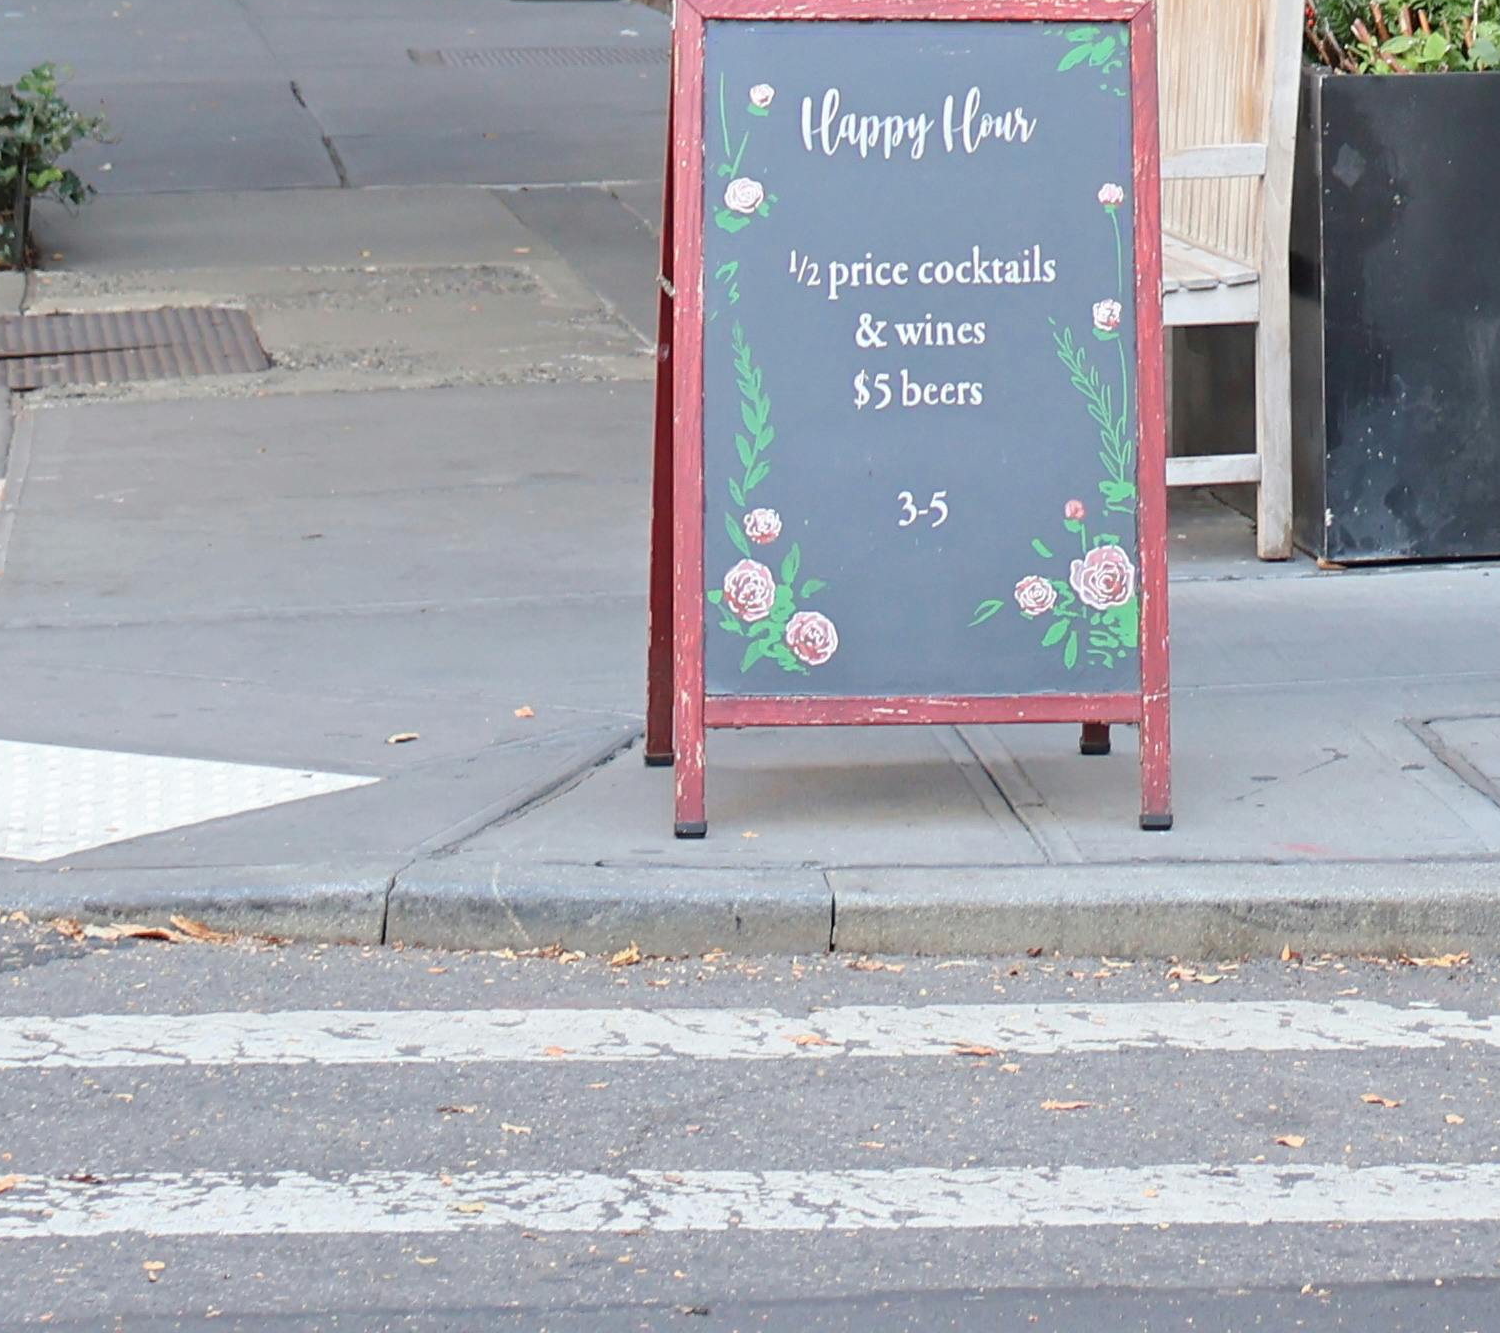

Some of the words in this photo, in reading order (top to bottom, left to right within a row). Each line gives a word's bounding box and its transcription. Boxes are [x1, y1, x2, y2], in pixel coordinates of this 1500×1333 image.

[801, 87, 934, 160] Happy
[942, 86, 1037, 154] Hour
[827, 252, 909, 300] price
[917, 244, 1057, 285] cocktails
[855, 312, 888, 348] &
[894, 313, 986, 346] wines
[853, 368, 892, 410] $5
[899, 368, 983, 407] beers
[897, 490, 949, 528] 3-5
